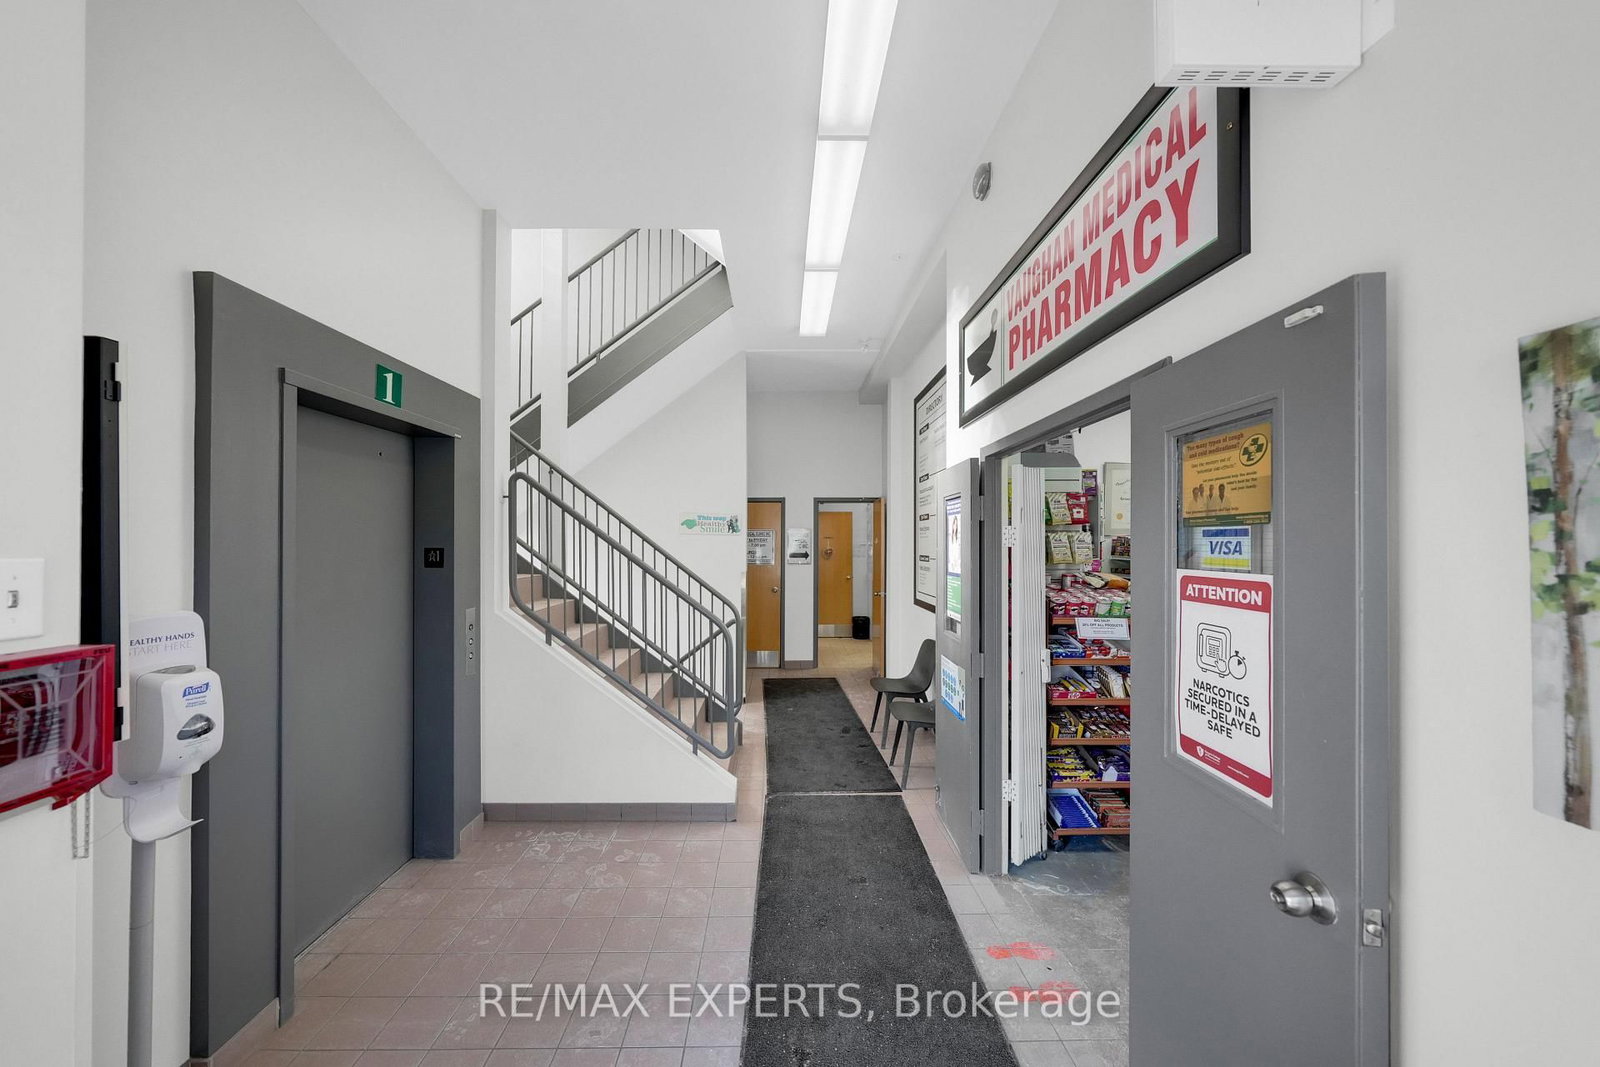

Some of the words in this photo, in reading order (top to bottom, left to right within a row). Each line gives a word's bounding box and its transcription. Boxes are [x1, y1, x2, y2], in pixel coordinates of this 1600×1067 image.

[1007, 219, 1076, 321] VAUGHAN
[1083, 87, 1207, 251] MEDICAL
[1008, 158, 1200, 371] PHARMACY
[382, 373, 396, 404] 1
[1208, 438, 1221, 448] types
[1222, 435, 1228, 443] of
[1228, 433, 1244, 443] cough
[1198, 449, 1207, 457] cold
[700, 526, 726, 534] Smile
[1208, 540, 1243, 556] VISA
[1186, 584, 1262, 606] ATTENTION
[129, 644, 160, 656] TART
[164, 641, 192, 652] HERE
[130, 636, 163, 646] EALTHY
[165, 632, 195, 642] HANDS
[1193, 679, 1250, 707] NARCOTICS
[1188, 688, 1232, 714] SECURED
[1234, 706, 1246, 720] IN
[1248, 711, 1257, 724] A
[1184, 698, 1261, 738] TIME-DELAYED
[1207, 720, 1233, 739] SAFE
